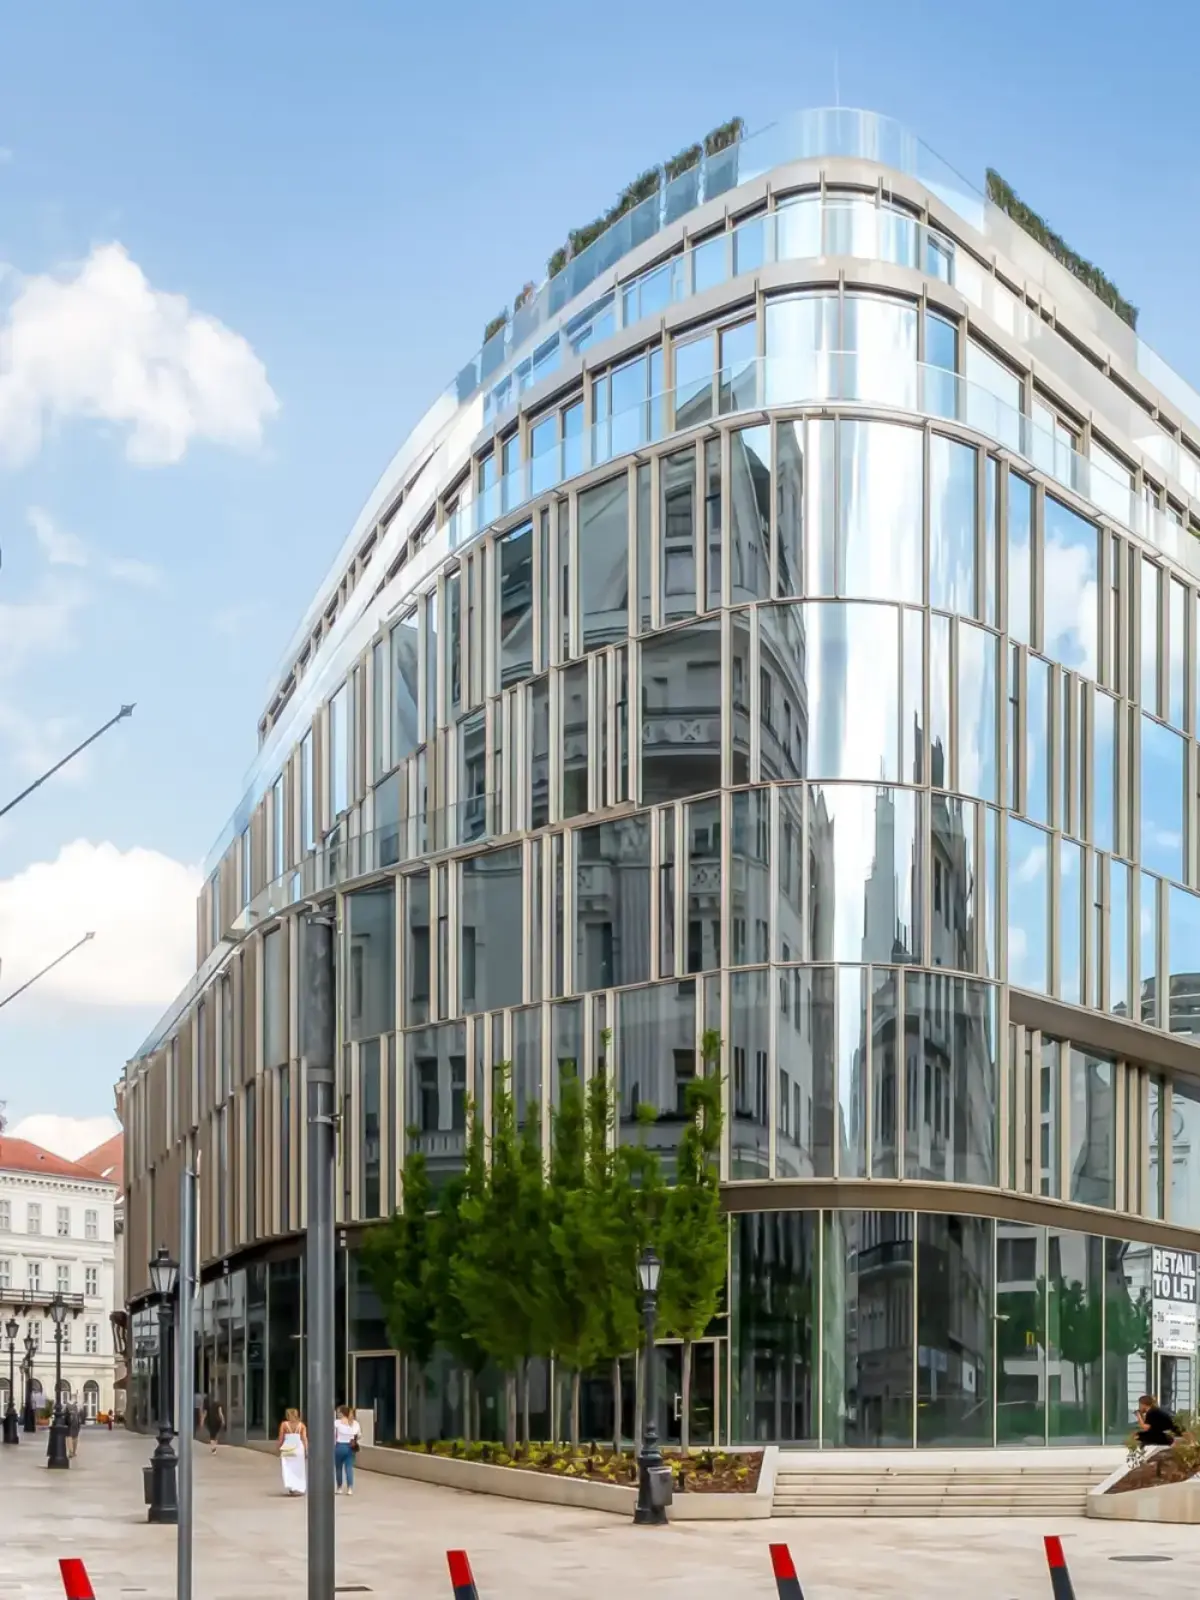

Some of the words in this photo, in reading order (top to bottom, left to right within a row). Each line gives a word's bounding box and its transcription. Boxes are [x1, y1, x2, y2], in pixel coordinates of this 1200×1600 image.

[1152, 1249, 1196, 1278] RETAIL
[1153, 1273, 1171, 1297] TO
[1173, 1276, 1196, 1301] LET
